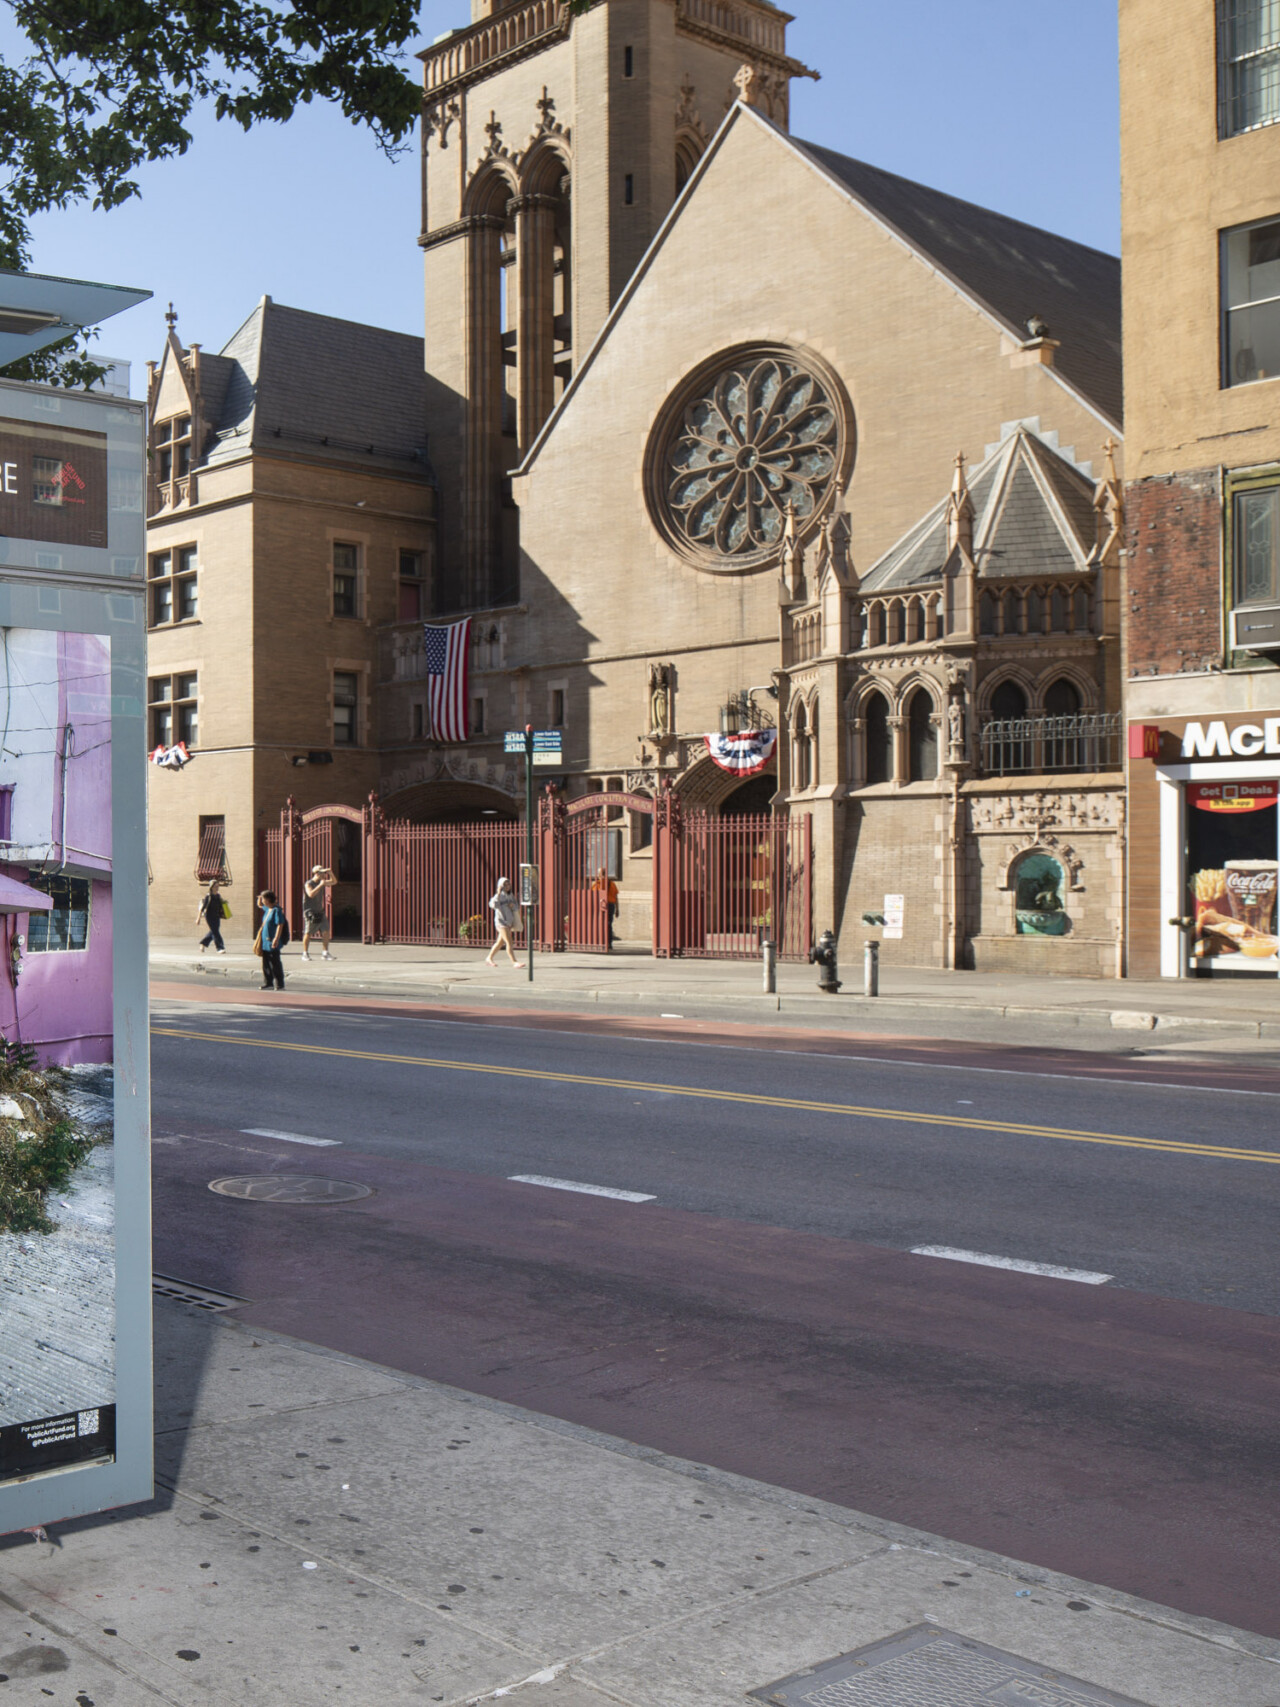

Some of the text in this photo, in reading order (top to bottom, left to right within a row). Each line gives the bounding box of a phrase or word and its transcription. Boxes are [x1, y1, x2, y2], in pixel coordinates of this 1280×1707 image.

[1200, 785, 1273, 796] Get Deals
[45, 1417, 75, 1427] information:
[27, 1425, 76, 1439] PublicArtFund.org
[32, 1432, 76, 1448] @PublicArtFund
